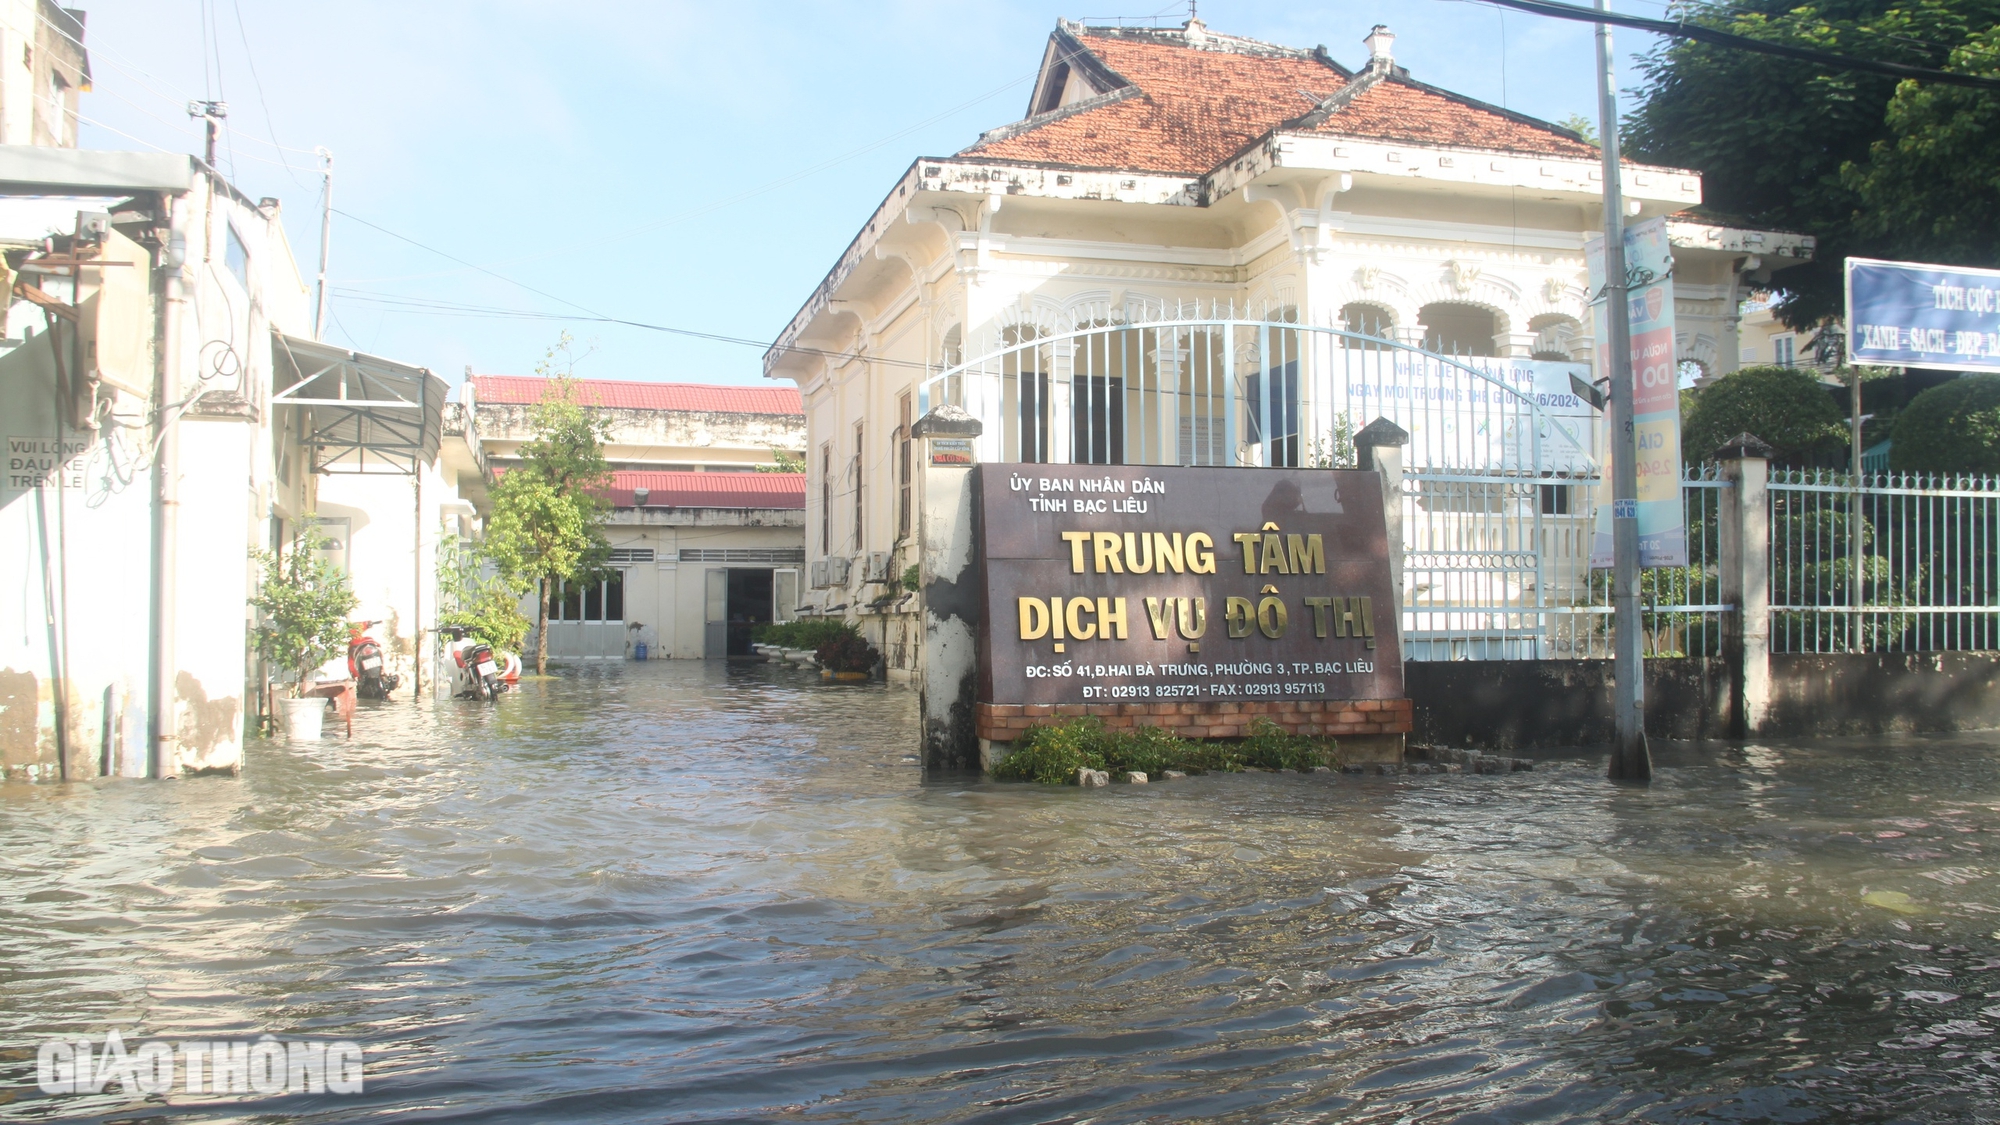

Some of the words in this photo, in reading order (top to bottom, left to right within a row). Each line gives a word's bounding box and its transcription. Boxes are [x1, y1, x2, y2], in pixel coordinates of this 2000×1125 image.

[1932, 279, 1964, 311] TÍCH
[1967, 285, 1994, 317] CỰC
[1910, 327, 1946, 357] SẠCH
[1509, 365, 1534, 383] ỨNG
[1348, 381, 1379, 398] NGÀY
[1385, 383, 1408, 399] MÔI
[10, 441, 37, 453] VUI
[9, 456, 52, 473] ĐẬU
[10, 472, 55, 487] TRÊN
[1010, 473, 1032, 491] ỦY
[1039, 478, 1074, 492] BAN
[1080, 476, 1125, 493] NHÂN
[1132, 477, 1165, 494] DÂN
[1029, 493, 1067, 512] TỈNH
[1073, 499, 1107, 515] BẠC
[1113, 496, 1148, 513] LIÊU
[1061, 531, 1216, 574] TRUNG
[1233, 521, 1326, 574] TÂM
[1018, 596, 1128, 653] DỊCH
[1145, 596, 1206, 653] VỤ
[1225, 584, 1288, 639] ĐÔ
[1304, 596, 1377, 650] THỊ
[1136, 661, 1156, 676] BÀ
[1215, 659, 1272, 675] PHƯỜNG
[1346, 658, 1374, 673] LIÊU
[1111, 685, 1150, 697] 02913
[1155, 684, 1200, 697] 825721
[1245, 683, 1281, 695] 02913
[1285, 682, 1325, 695] 957113
